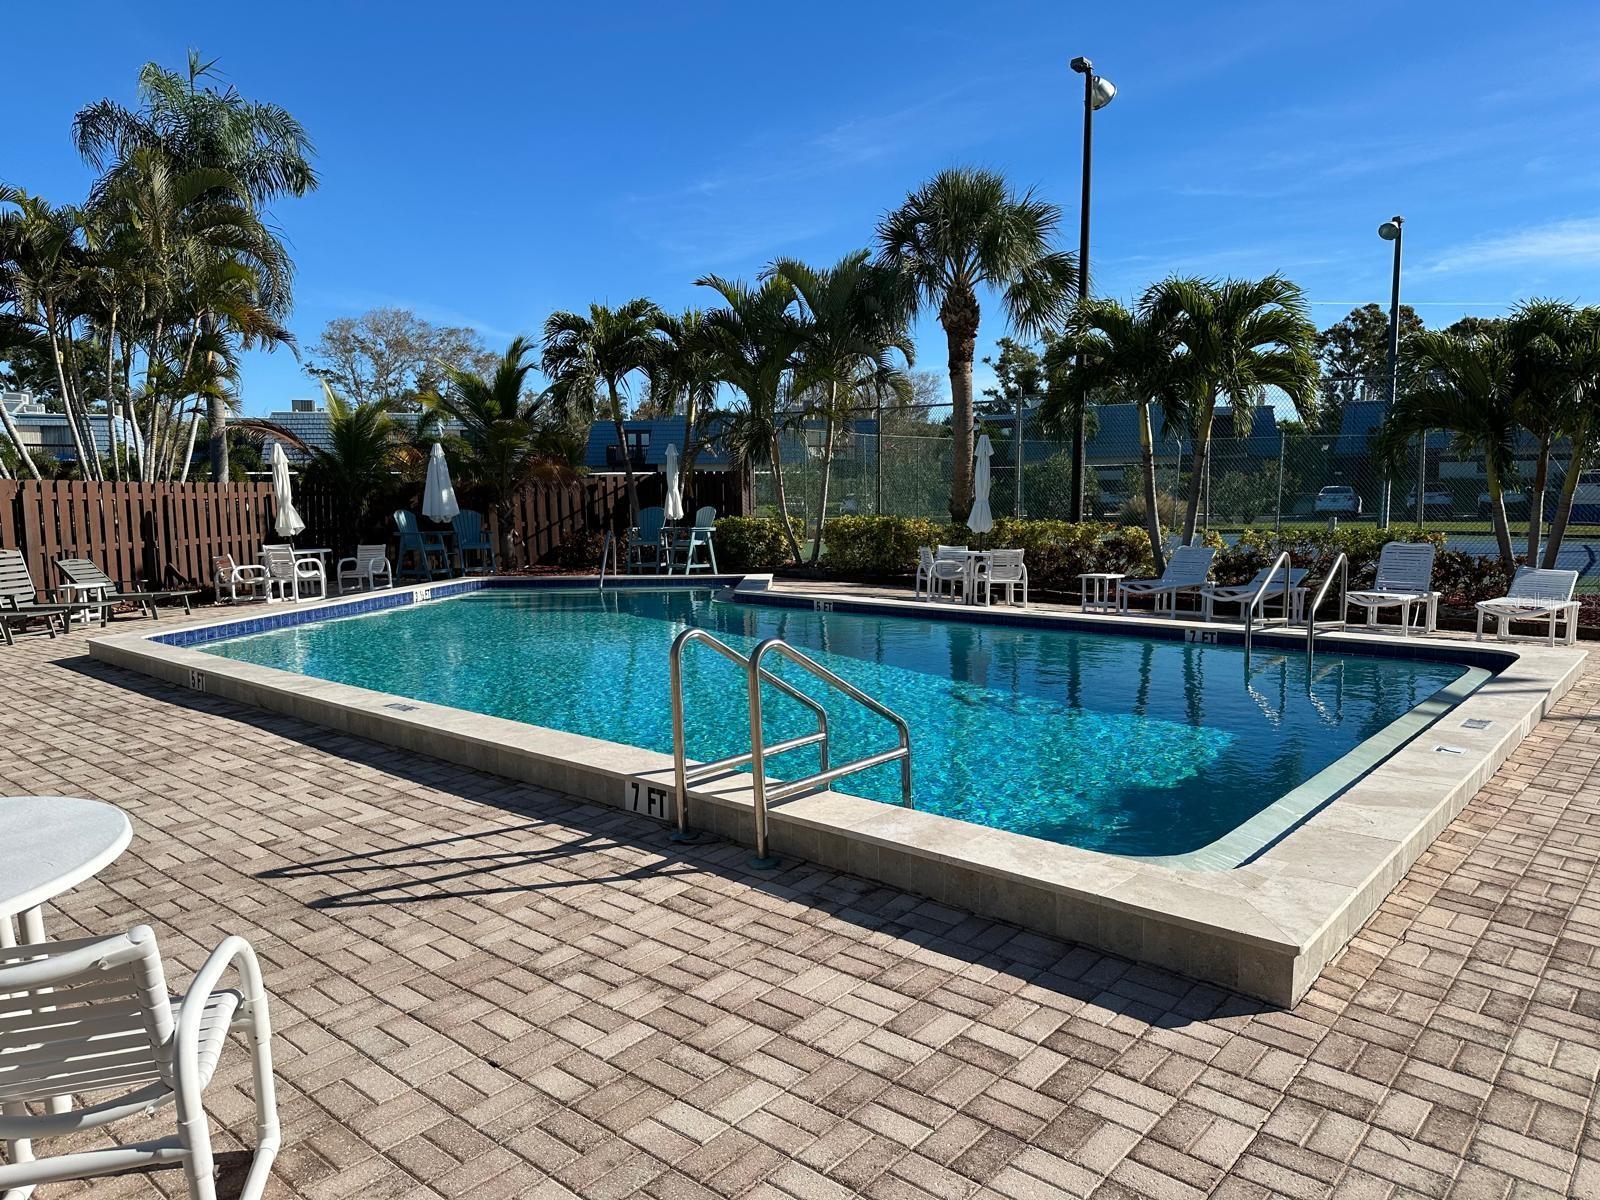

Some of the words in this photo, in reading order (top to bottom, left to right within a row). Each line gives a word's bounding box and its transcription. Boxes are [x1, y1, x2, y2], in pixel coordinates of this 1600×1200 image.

[1190, 630, 1196, 642] 7
[1202, 631, 1216, 644] FT
[632, 781, 639, 811] 7
[648, 786, 667, 818] FT
